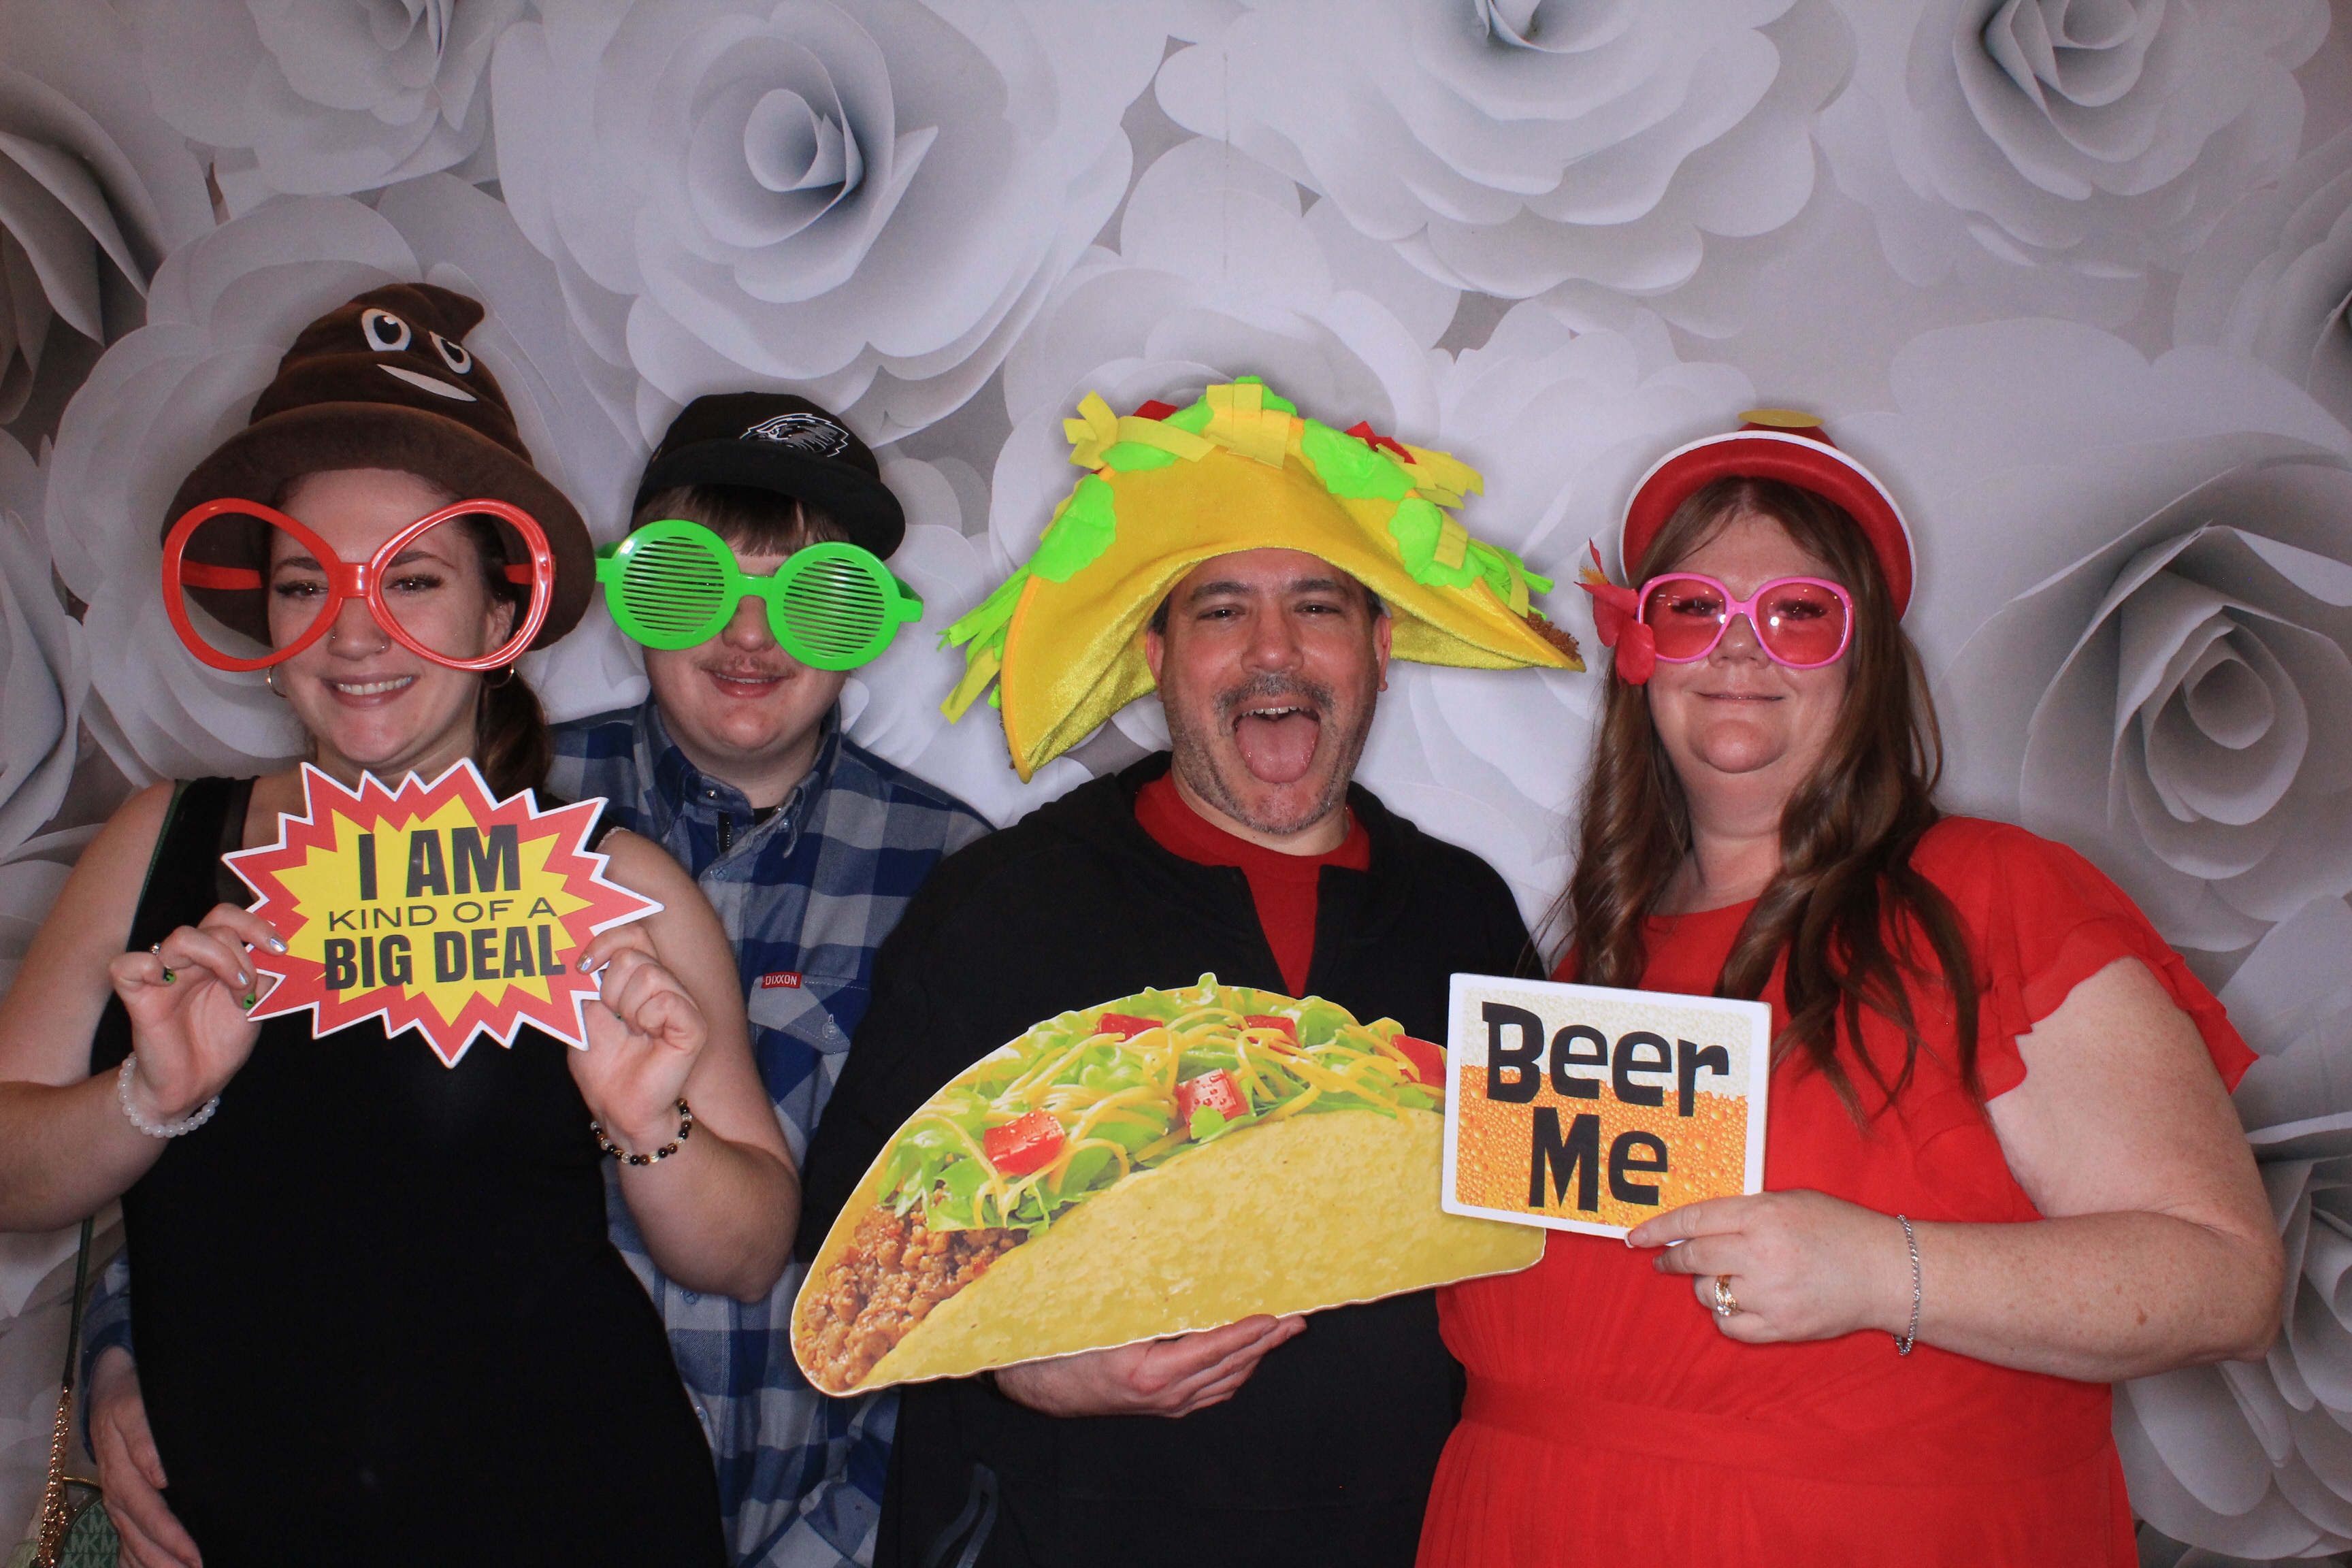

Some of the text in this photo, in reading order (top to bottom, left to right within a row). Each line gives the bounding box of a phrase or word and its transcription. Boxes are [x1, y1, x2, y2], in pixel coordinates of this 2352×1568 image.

[358, 824, 521, 900] I AM
[329, 897, 558, 931] KIND OF A
[324, 924, 566, 991] BIG DEAL
[765, 974, 797, 985] DIXXON
[1482, 1001, 1729, 1117] Beer
[1529, 1106, 1668, 1213] Me
